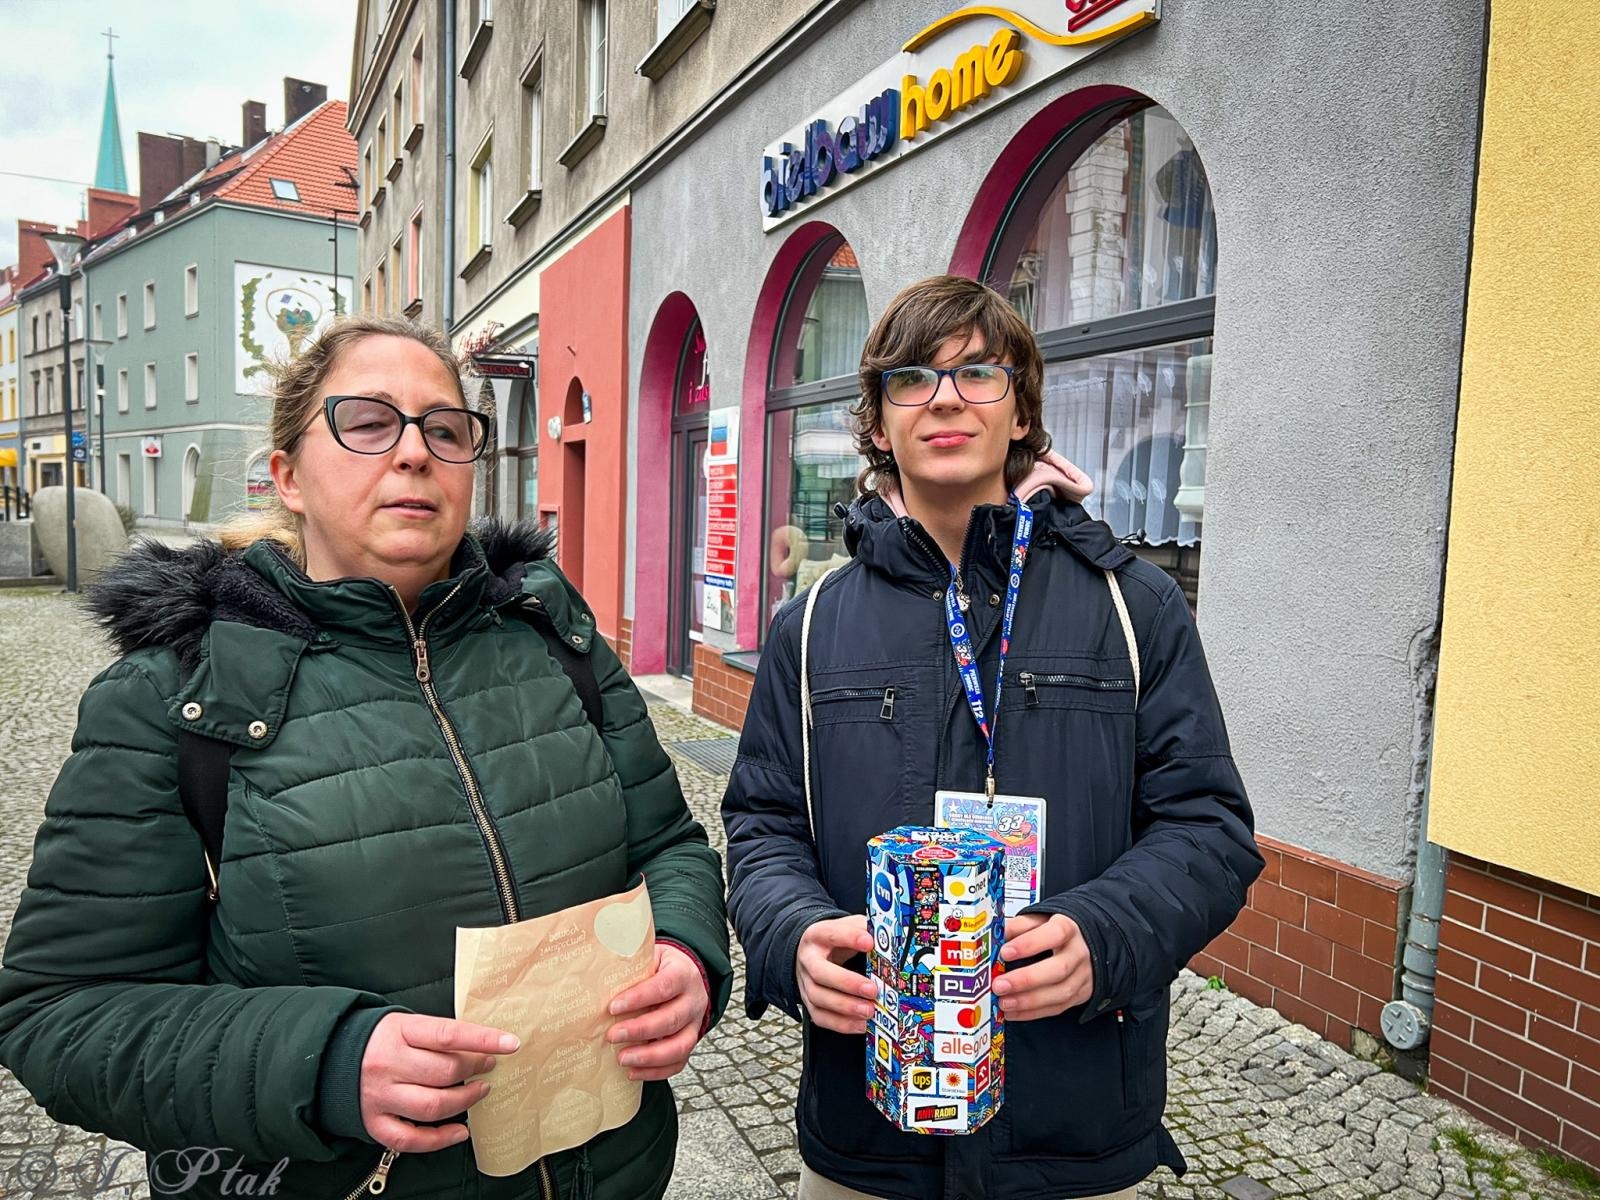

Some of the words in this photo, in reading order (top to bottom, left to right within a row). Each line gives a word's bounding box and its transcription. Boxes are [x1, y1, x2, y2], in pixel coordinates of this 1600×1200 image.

[900, 29, 1024, 141] home
[956, 645, 971, 660] 33
[970, 699, 983, 719] 112
[998, 814, 1025, 832] 33
[876, 882, 891, 903] tvn
[968, 877, 986, 894] onet
[946, 940, 988, 960] mBank
[944, 971, 987, 994] PLAY
[941, 1032, 988, 1057] allegro
[913, 1076, 931, 1088] ups
